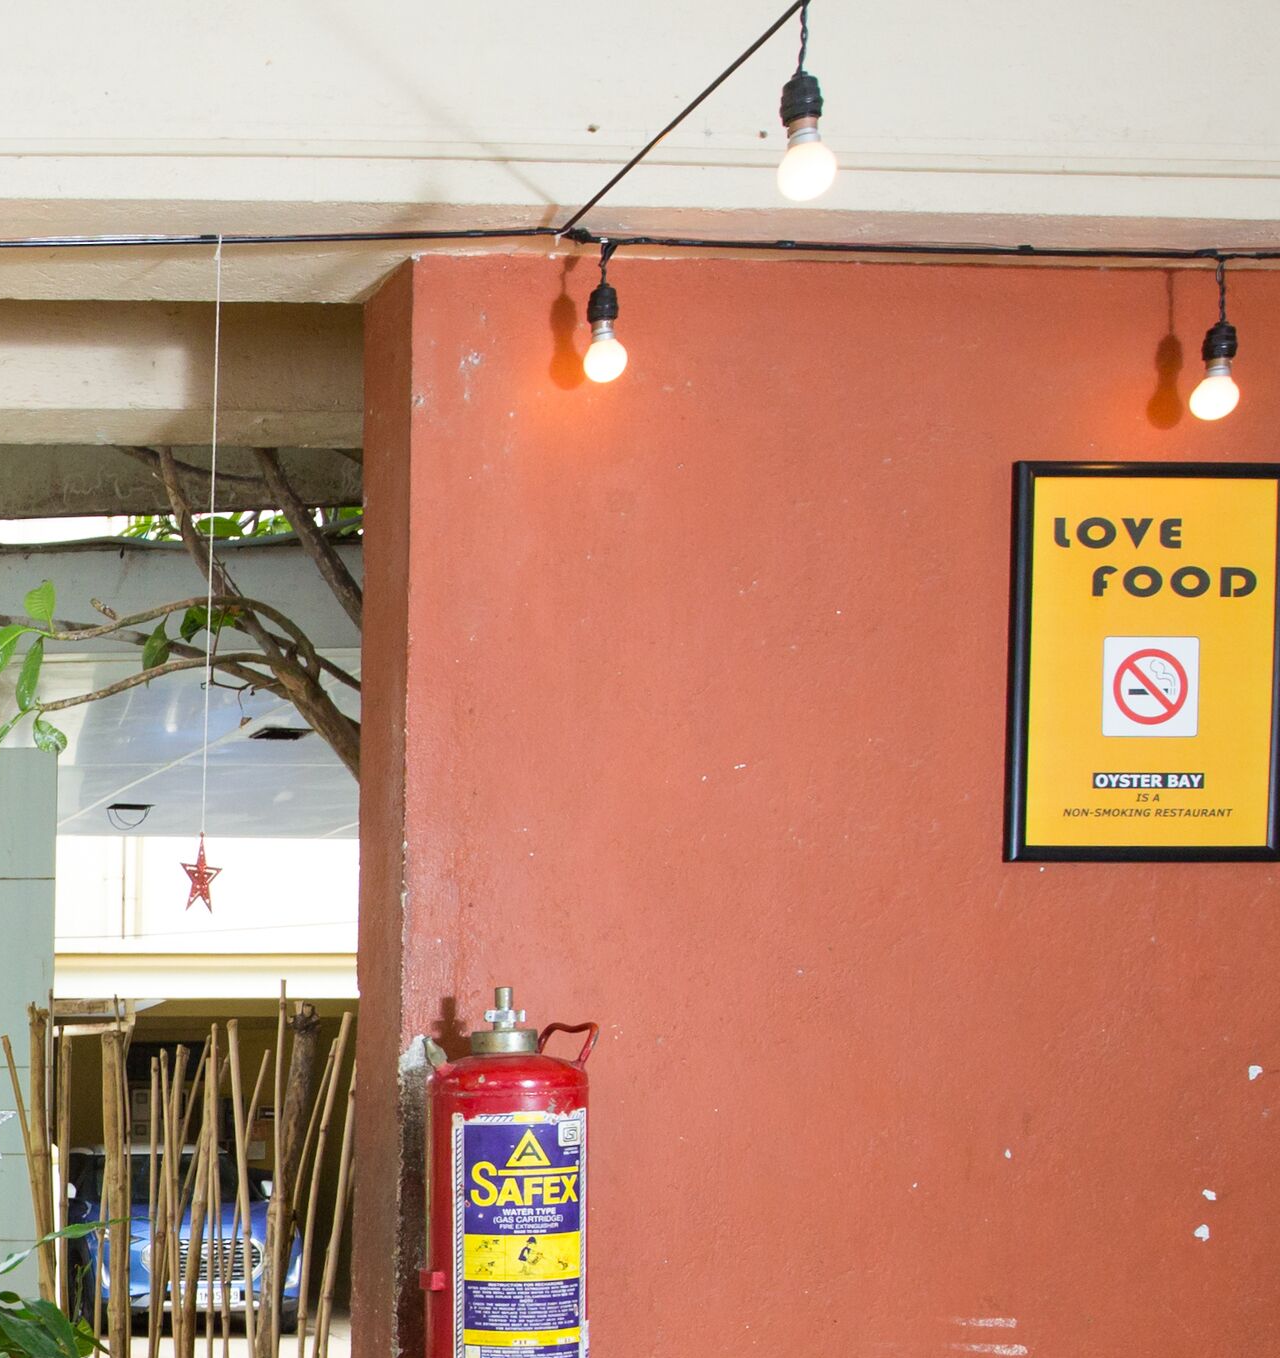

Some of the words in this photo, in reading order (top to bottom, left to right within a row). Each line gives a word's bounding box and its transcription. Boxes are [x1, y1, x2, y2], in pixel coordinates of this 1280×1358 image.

[1054, 517, 1182, 549] LOVE
[1092, 565, 1257, 598] FOOD
[1095, 774, 1162, 788] OYSTER
[1167, 774, 1203, 788] BAY
[1136, 793, 1149, 802] IS
[1152, 793, 1160, 802] A
[1063, 808, 1151, 817] NON-SMOKING
[1154, 808, 1233, 817] RESTAURANT
[517, 1140, 542, 1162] A
[470, 1161, 578, 1207] SAFEX
[502, 1208, 534, 1216] WATER
[535, 1207, 557, 1215] TYPE
[493, 1216, 514, 1224] (GAS
[516, 1214, 564, 1223] CARTRIDGE)
